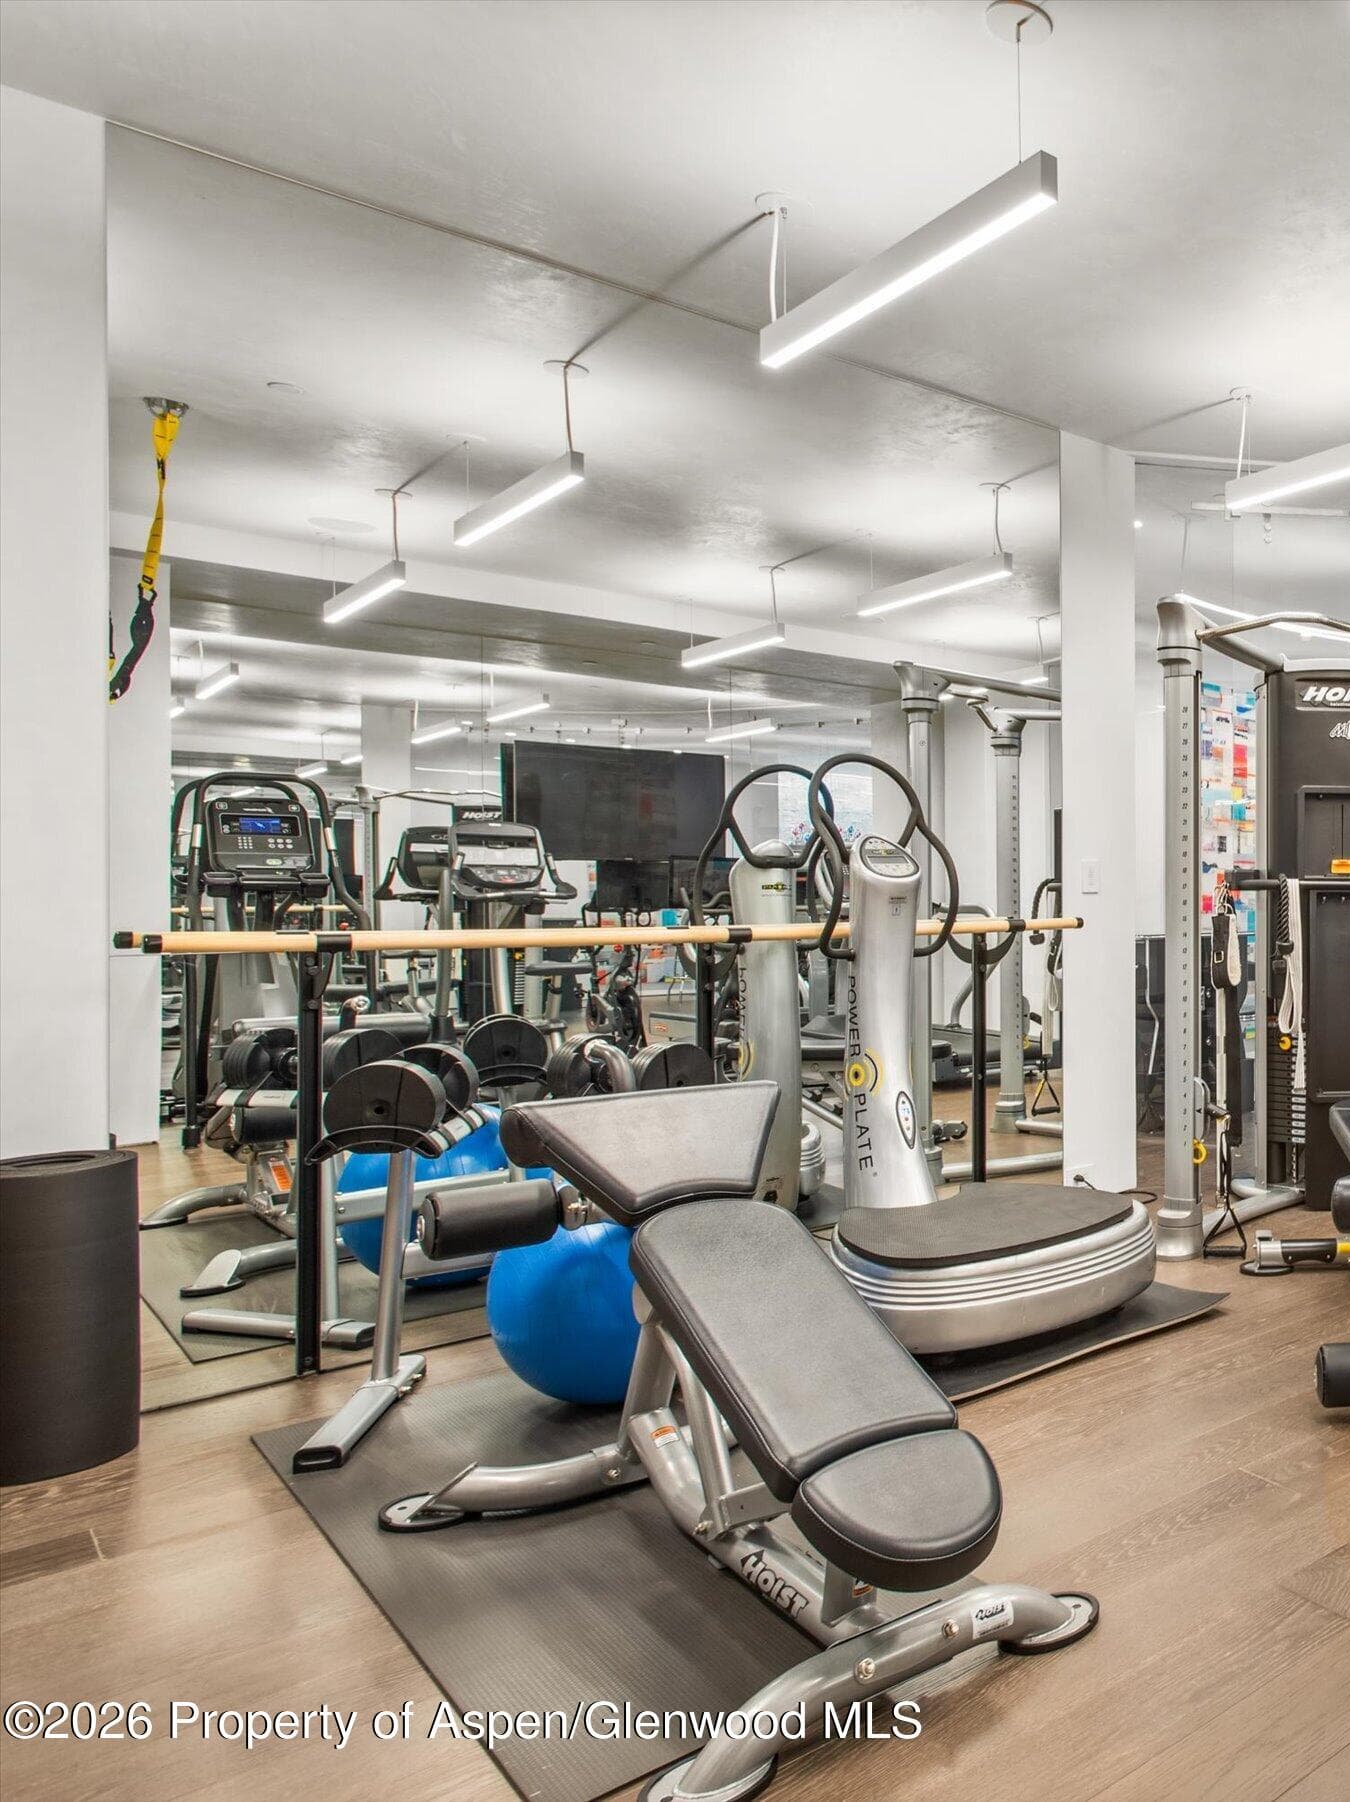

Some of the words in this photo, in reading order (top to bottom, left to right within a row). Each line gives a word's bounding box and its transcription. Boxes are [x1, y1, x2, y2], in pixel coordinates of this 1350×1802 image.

[848, 976, 861, 1058] POWER
[854, 1093, 874, 1171] PLATE
[741, 1553, 808, 1619] HOIST
